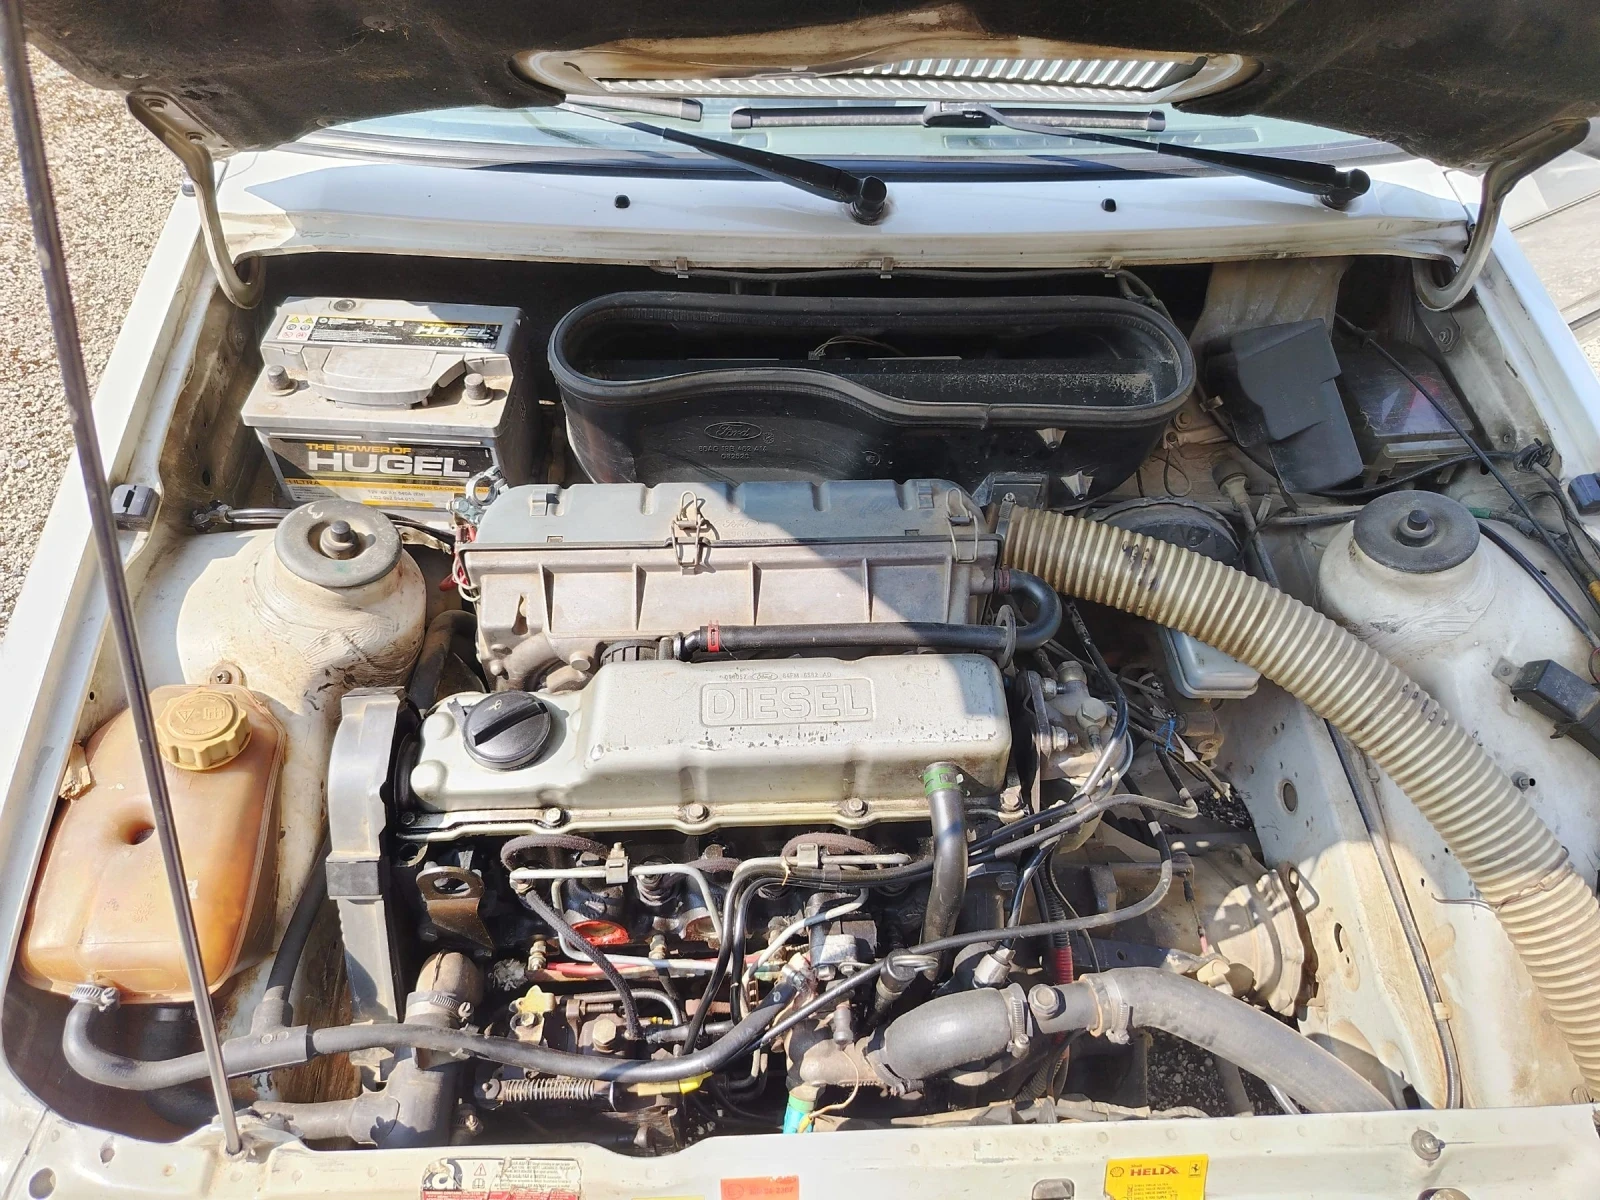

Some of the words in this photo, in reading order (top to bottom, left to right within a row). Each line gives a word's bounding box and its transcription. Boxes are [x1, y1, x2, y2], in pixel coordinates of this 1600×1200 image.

[415, 326, 490, 337] HUGEL
[716, 423, 752, 437] Ford
[306, 443, 335, 451] THE
[336, 445, 390, 453] POWER
[308, 451, 470, 477] HUGEL
[706, 684, 868, 721] DIESEL
[1130, 1164, 1179, 1176] HELIX
